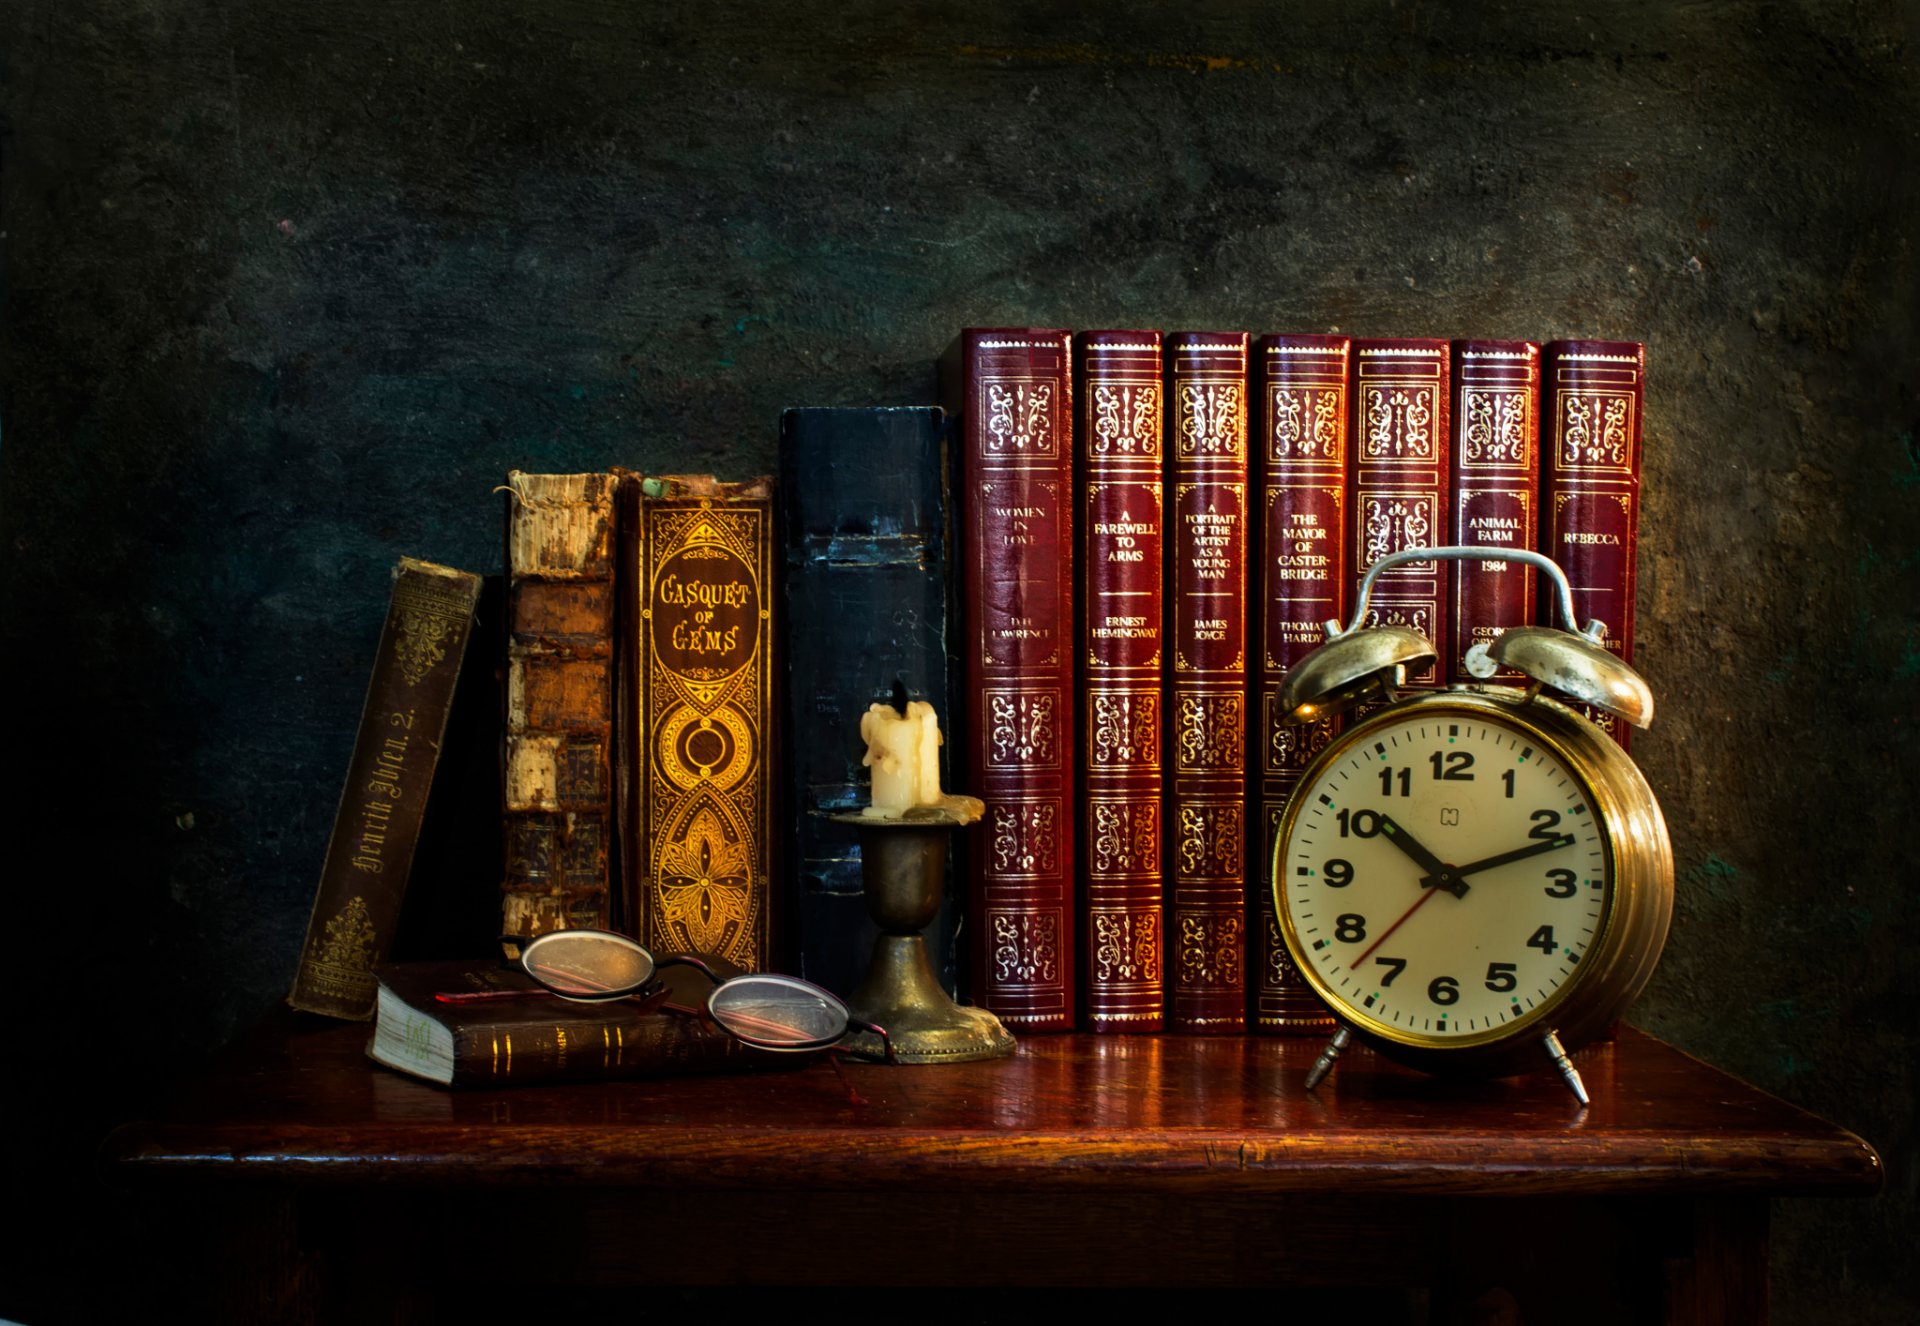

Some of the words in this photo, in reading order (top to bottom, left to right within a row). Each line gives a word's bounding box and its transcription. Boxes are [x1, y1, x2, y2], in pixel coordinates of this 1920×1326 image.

[995, 507, 1045, 518] WOMEN
[1208, 503, 1216, 513] A
[1120, 510, 1131, 521] A
[1185, 514, 1237, 524] PORTRAIT
[1291, 514, 1318, 525] THE
[1014, 521, 1028, 531] IN
[1095, 523, 1157, 535] FAREWELL
[1469, 517, 1521, 529] ANIMAL
[1191, 525, 1207, 535] OF
[1208, 525, 1231, 535] THE
[1282, 528, 1327, 539] MAYOR
[1477, 530, 1513, 541] FARM
[1004, 535, 1037, 546] LOVE
[1115, 536, 1135, 548] TO
[1193, 536, 1231, 546] ARTIST
[1564, 533, 1620, 545] REBECCA
[1199, 547, 1213, 557] AS
[1214, 547, 1223, 557] A
[1295, 541, 1314, 553] OF
[1108, 550, 1144, 562] ARMS
[1277, 555, 1331, 567] CASTER-
[1192, 558, 1231, 568] YOUNG
[1481, 560, 1507, 572] 1984
[1198, 569, 1225, 579] MAN
[1280, 569, 1328, 580] BRIDGE
[695, 611, 714, 624] OF
[1105, 616, 1147, 627] ERNEST
[1193, 619, 1228, 629] JAMES
[1280, 621, 1324, 632] THOMA
[672, 620, 740, 656] GEMS
[1092, 628, 1158, 639] HEMINGWAY
[1193, 630, 1226, 640] JOYCE
[1283, 633, 1323, 643] HARDY
[1429, 751, 1474, 781] 12
[1378, 766, 1411, 797] 11
[1501, 769, 1514, 798] 1
[1336, 808, 1381, 838] 10
[1528, 809, 1562, 840] 2
[352, 801, 393, 874] Henrik
[1323, 859, 1354, 888] 9
[1544, 868, 1577, 899] 3
[1334, 913, 1366, 943] 8
[1526, 925, 1559, 955] 4
[1375, 957, 1407, 987] 7
[1484, 962, 1517, 992] 5
[1428, 976, 1460, 1006] 6
